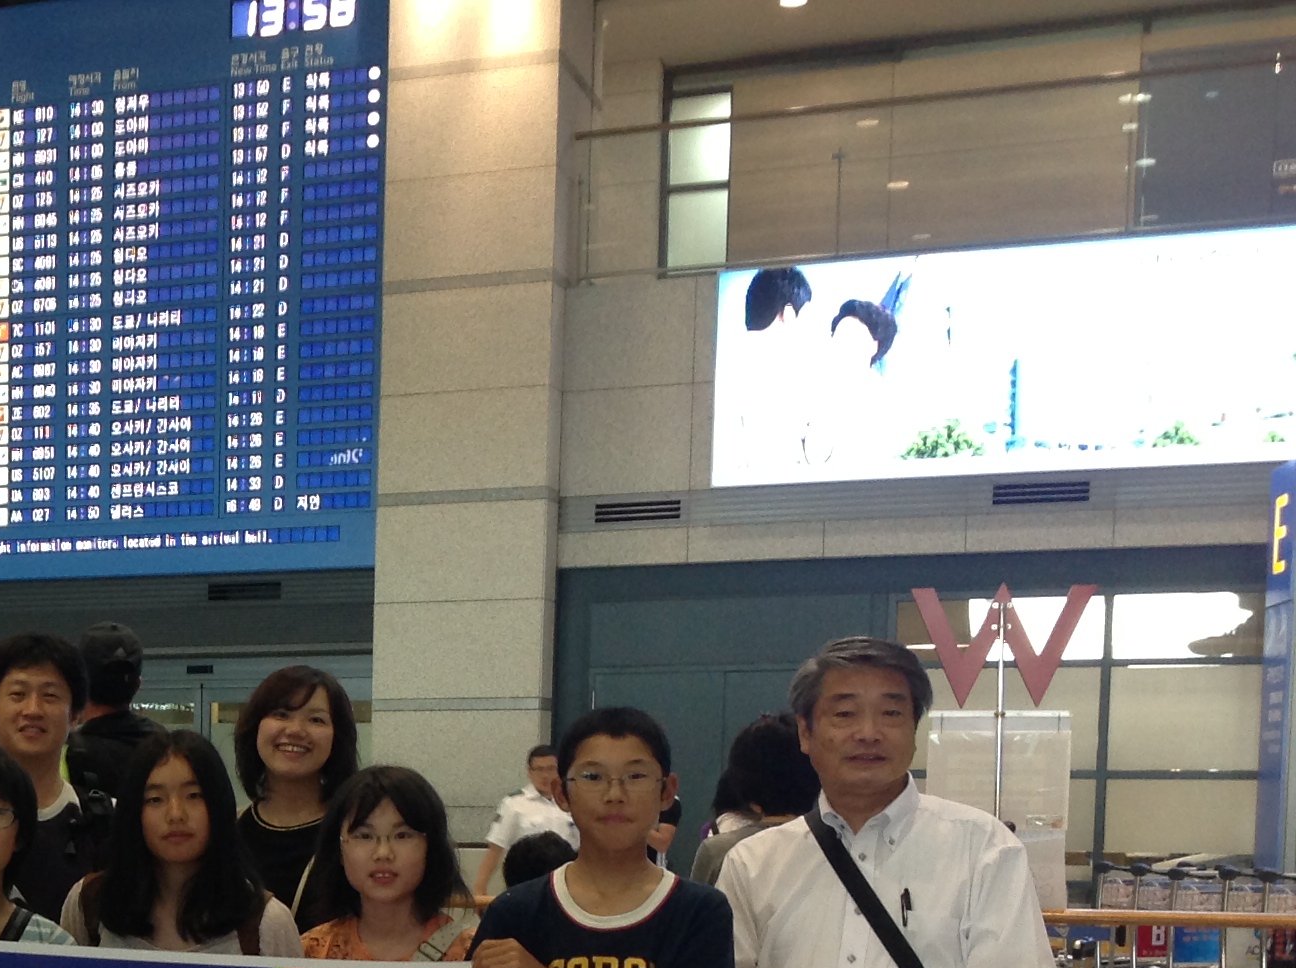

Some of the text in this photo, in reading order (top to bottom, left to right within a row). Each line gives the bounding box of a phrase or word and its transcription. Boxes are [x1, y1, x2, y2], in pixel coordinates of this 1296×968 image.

[12, 82, 136, 102] Flight Time From
[231, 56, 334, 77] New Time Exit Status
[1272, 493, 1289, 575] E
[911, 582, 1098, 710] W
